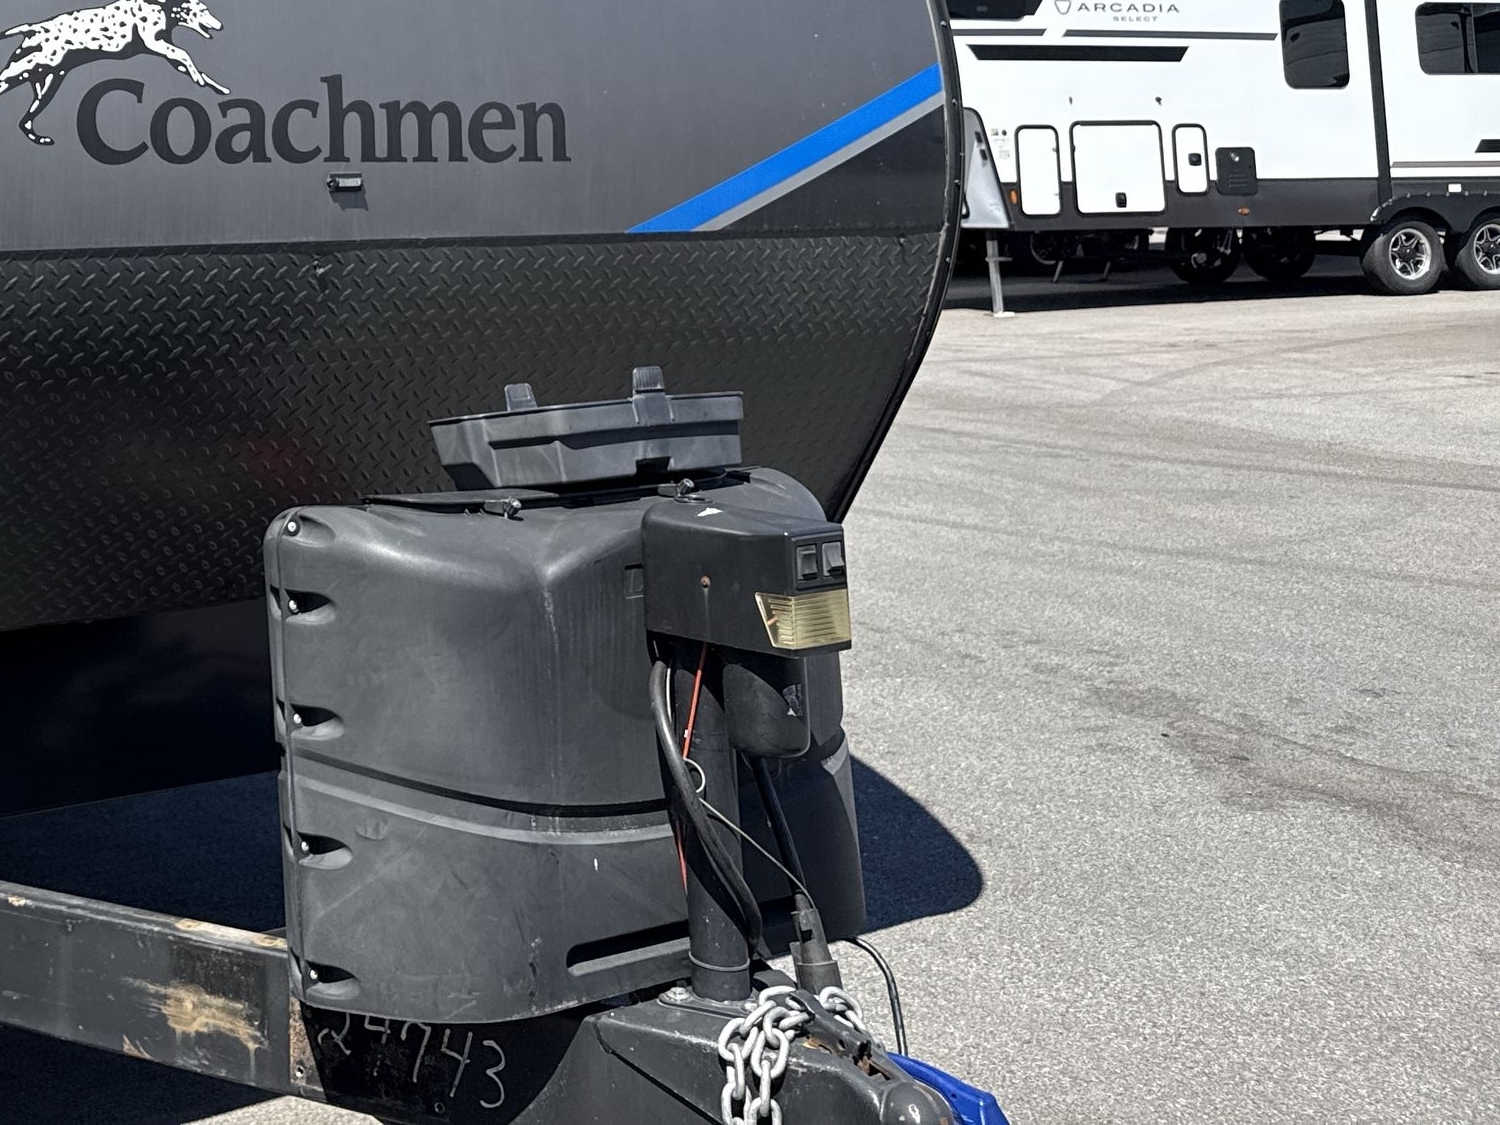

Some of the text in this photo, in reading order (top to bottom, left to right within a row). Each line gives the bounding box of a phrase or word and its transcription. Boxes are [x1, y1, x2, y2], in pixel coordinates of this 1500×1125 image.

[1076, 2, 1181, 14] ARCADIA
[1112, 15, 1158, 23] SELECT
[76, 73, 572, 166] Coachmen
